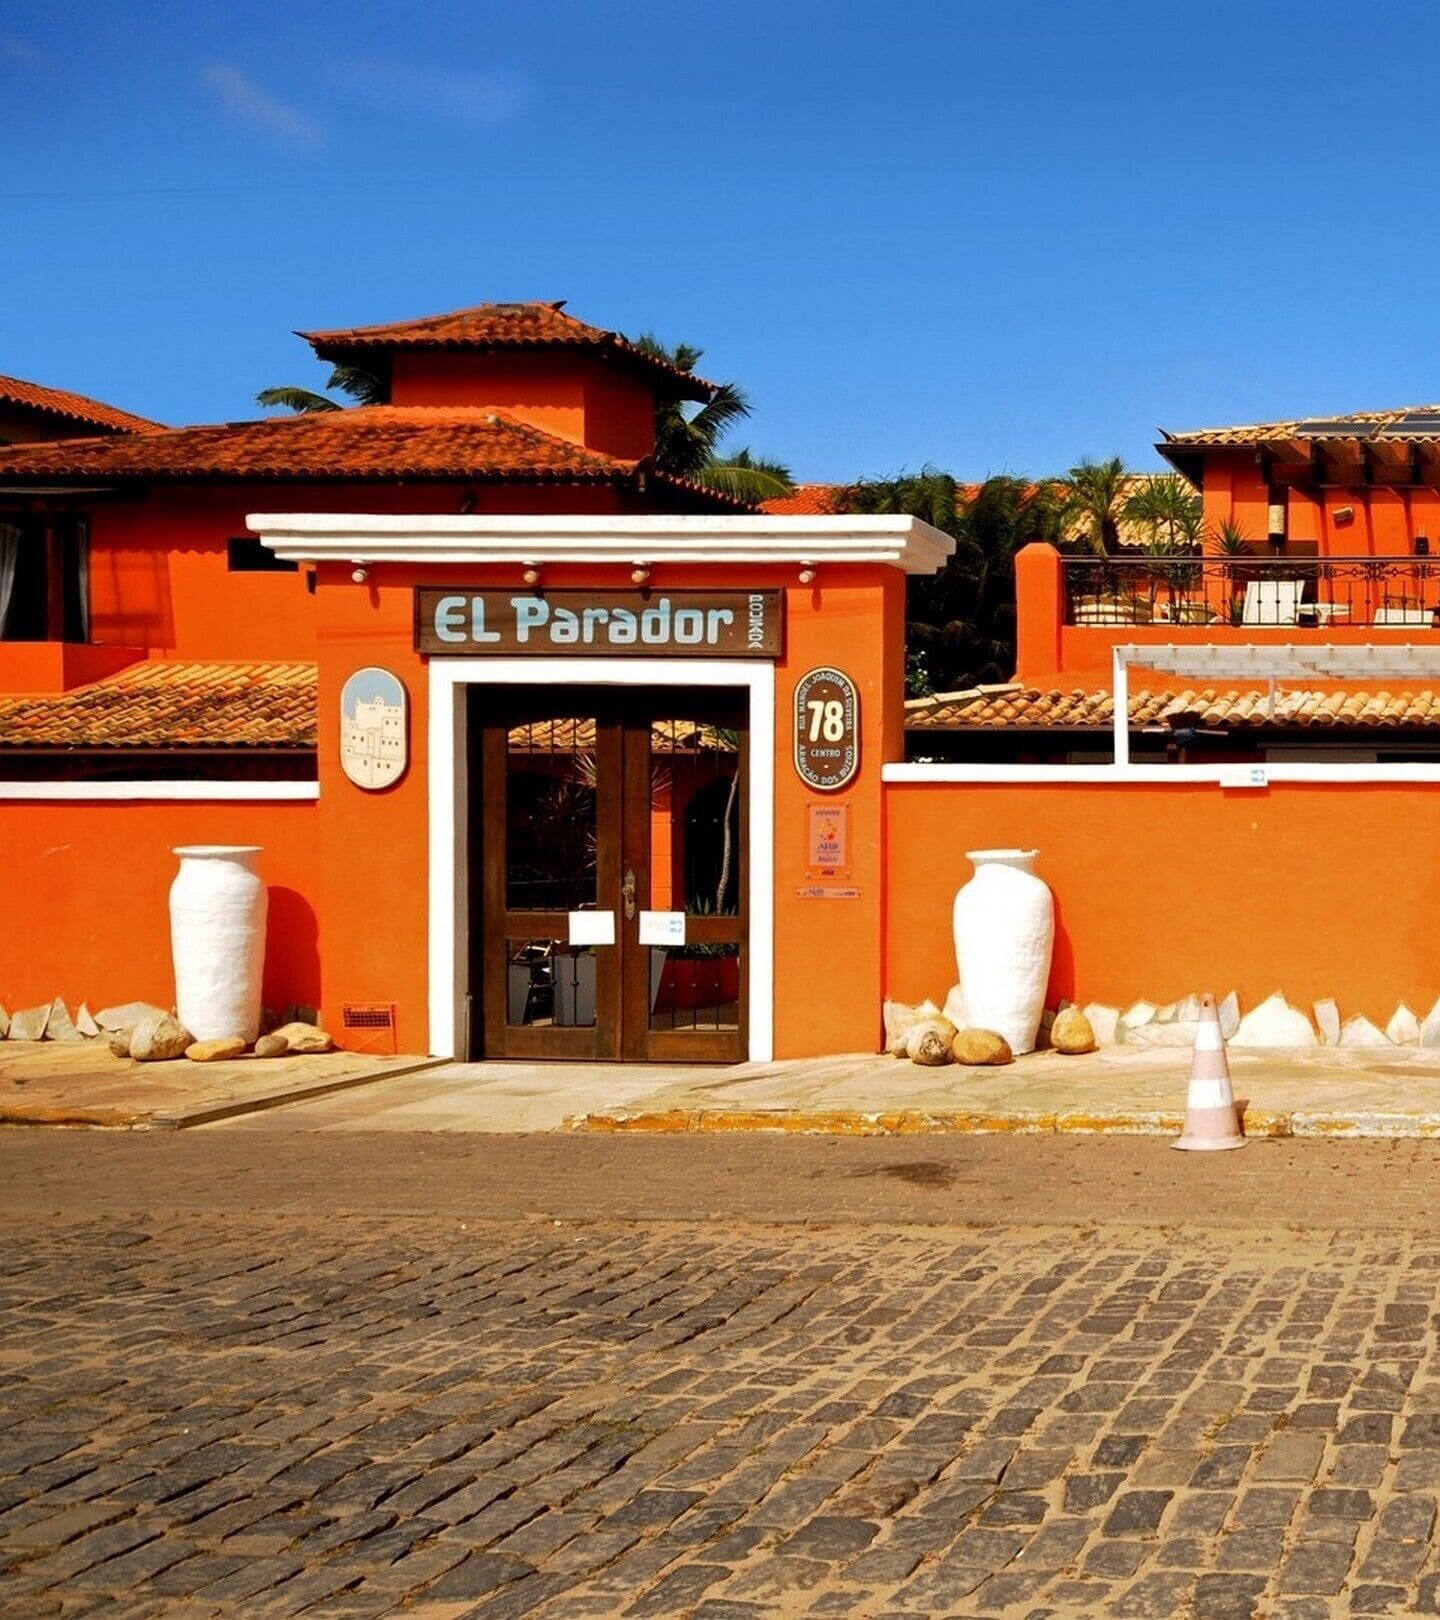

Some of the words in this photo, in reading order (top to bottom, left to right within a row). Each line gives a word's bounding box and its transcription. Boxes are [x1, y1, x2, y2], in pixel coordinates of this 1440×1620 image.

[510, 597, 734, 645] Parador
[748, 594, 764, 649] POUSADA
[807, 700, 844, 742] 78
[810, 749, 840, 758] CENTRO
[821, 776, 839, 785] DOS
